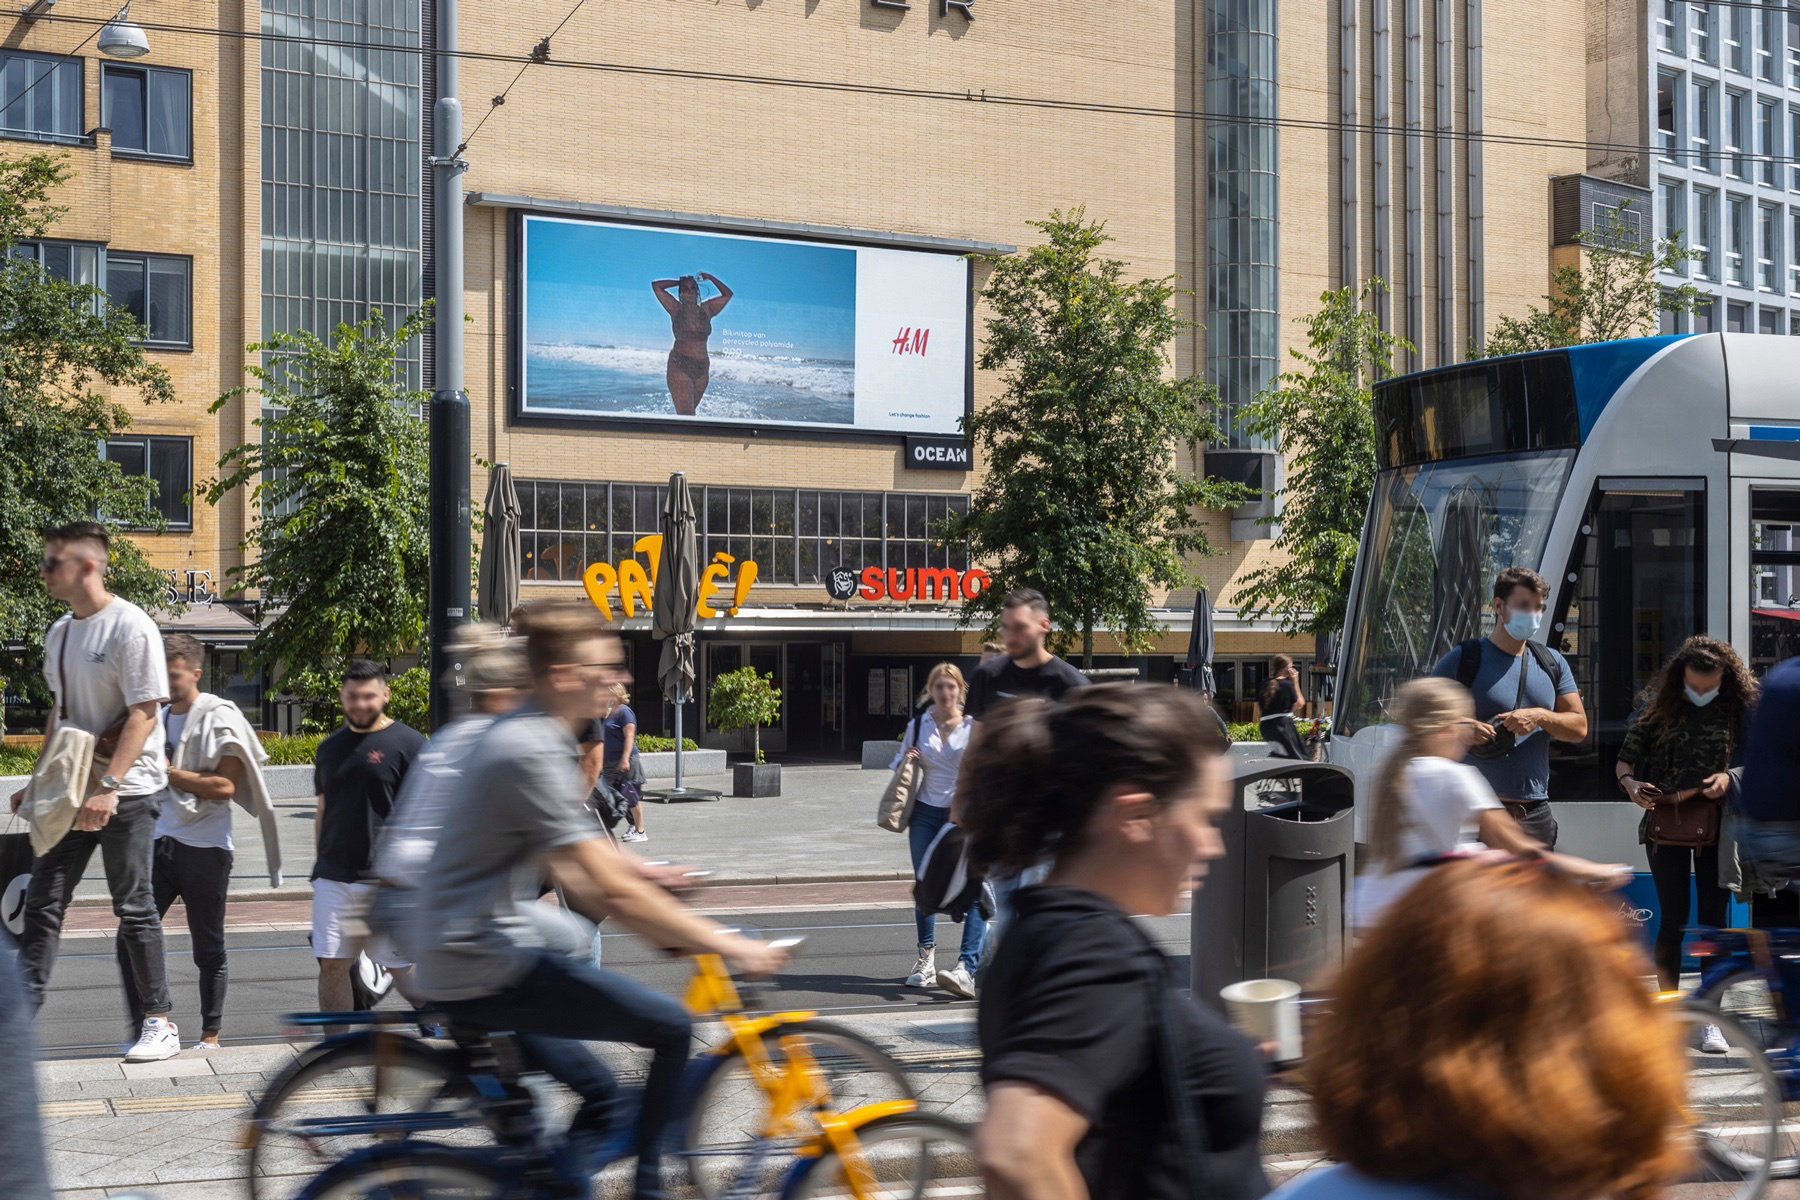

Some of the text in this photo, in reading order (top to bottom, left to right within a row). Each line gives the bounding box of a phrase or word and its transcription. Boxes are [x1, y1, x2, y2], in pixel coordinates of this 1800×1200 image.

[722, 328, 753, 338] Bikinitop
[722, 338, 794, 349] gerecycled polyamide
[892, 327, 930, 357] H&M
[914, 446, 967, 462] OCEAN
[583, 535, 758, 622] PATÉ!
